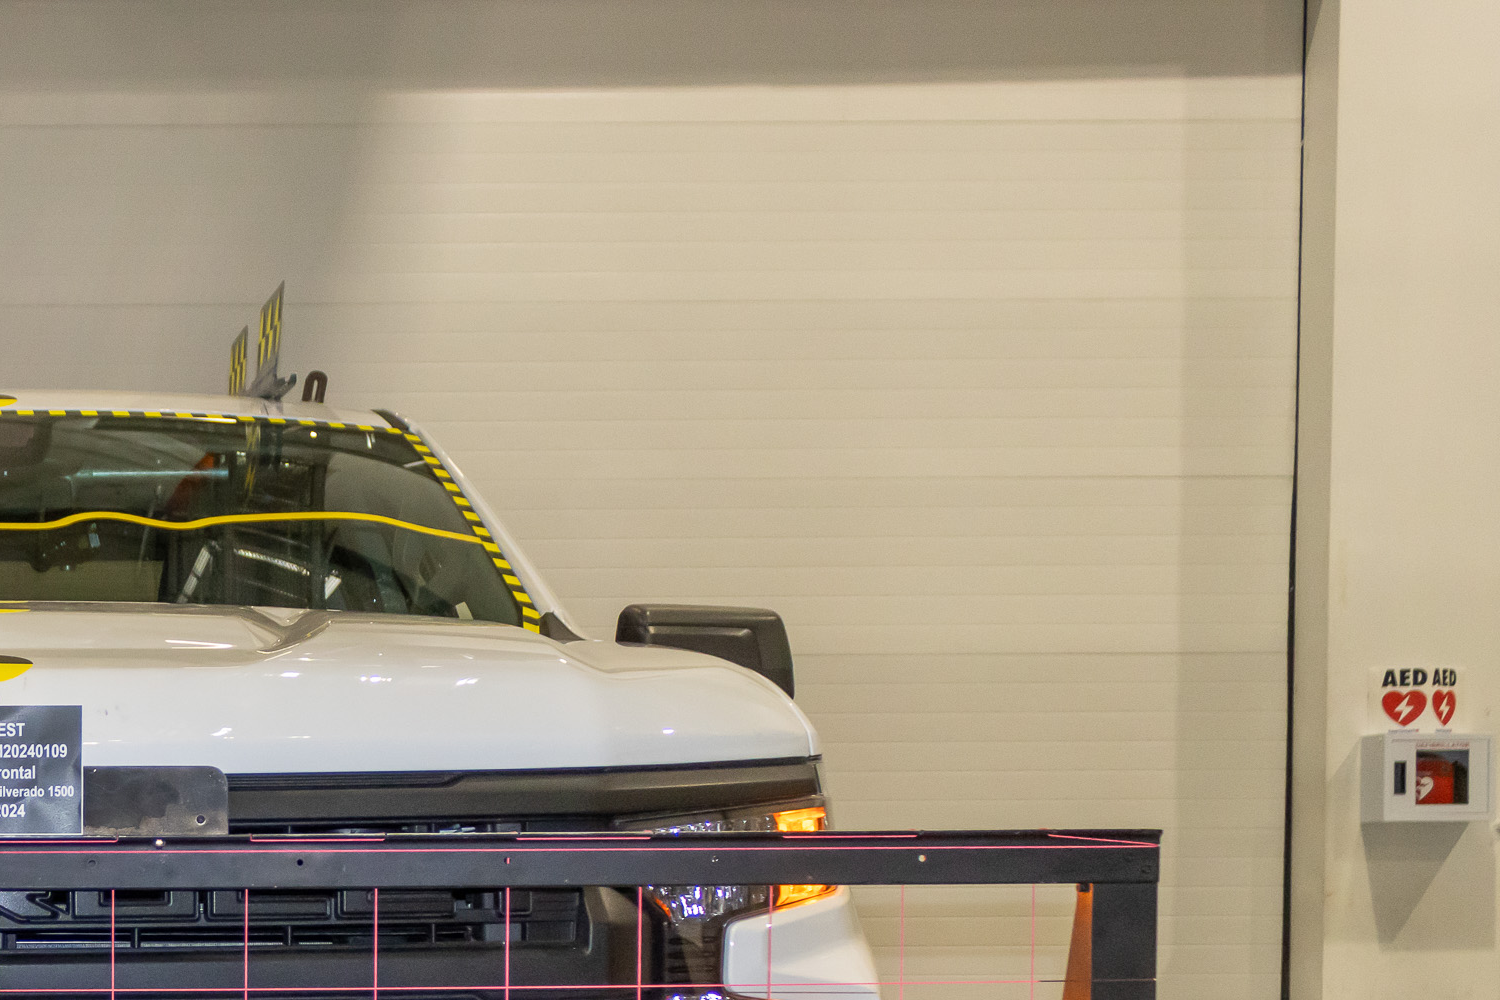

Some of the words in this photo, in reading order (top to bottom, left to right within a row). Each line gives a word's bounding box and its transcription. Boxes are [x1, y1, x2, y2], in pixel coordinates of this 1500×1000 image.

[1381, 668, 1428, 687] AED
[1432, 668, 1457, 687] AED
[48, 785, 75, 798] 1500
